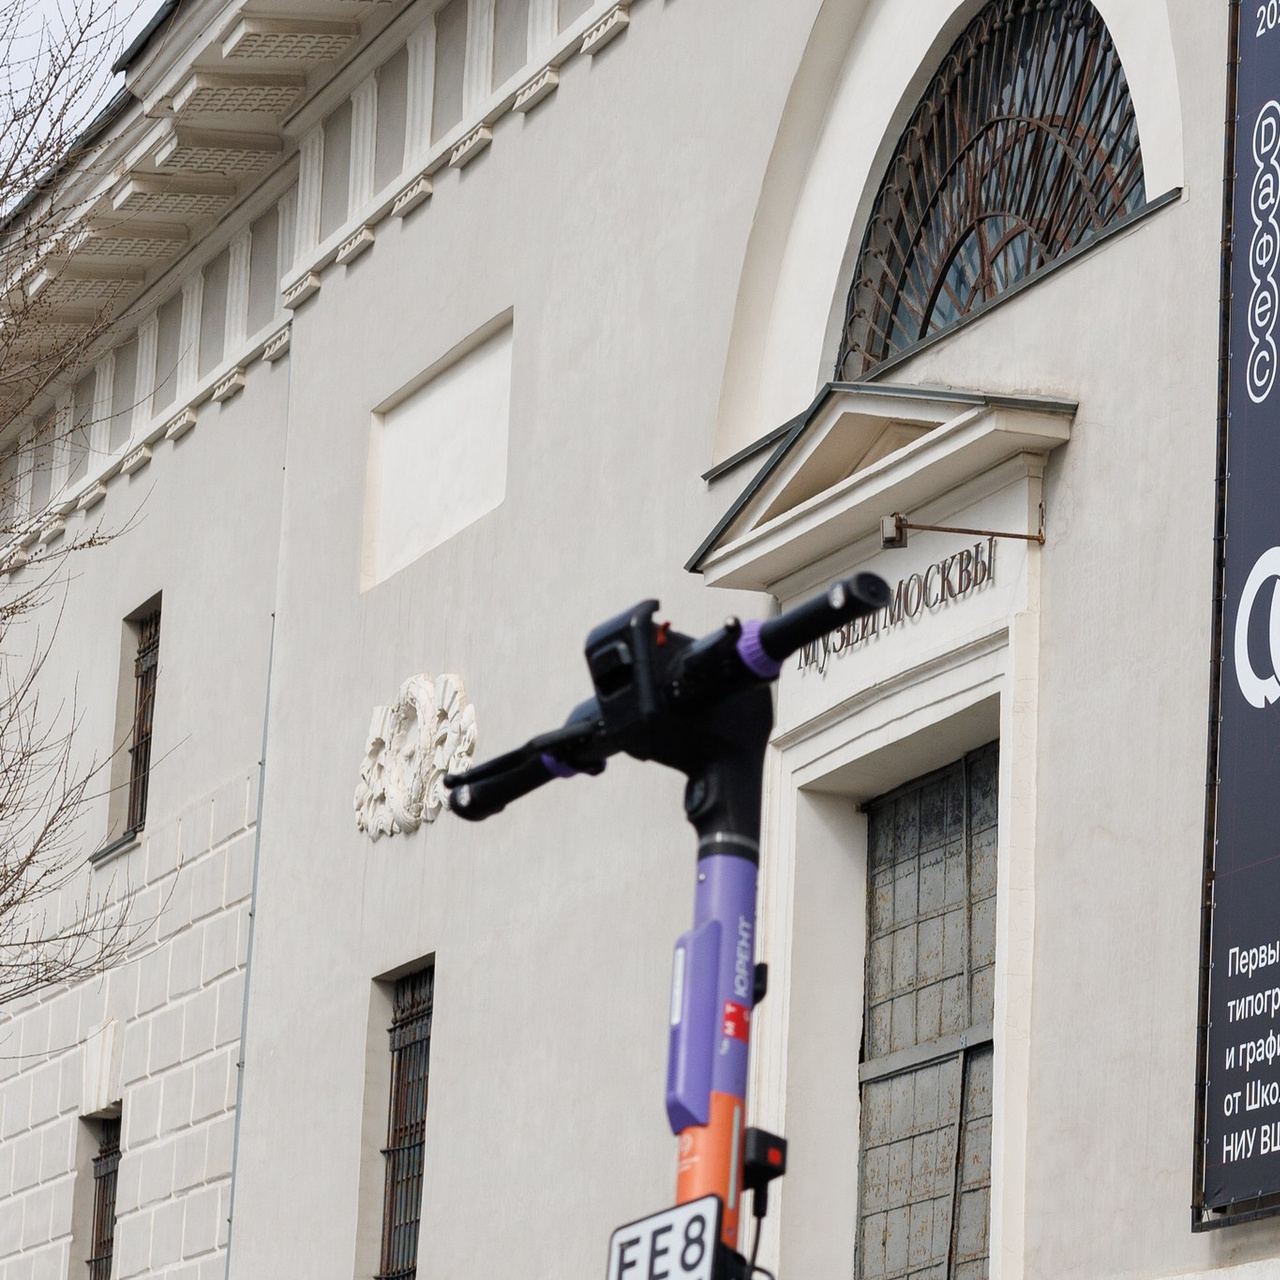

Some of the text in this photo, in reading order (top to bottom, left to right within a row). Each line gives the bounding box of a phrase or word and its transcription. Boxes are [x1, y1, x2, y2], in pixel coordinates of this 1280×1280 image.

[881, 535, 997, 630] МОСКВЫ
[1225, 1046, 1235, 1070] и
[1223, 1091, 1242, 1117] от
[1222, 1127, 1257, 1164] НИУ
